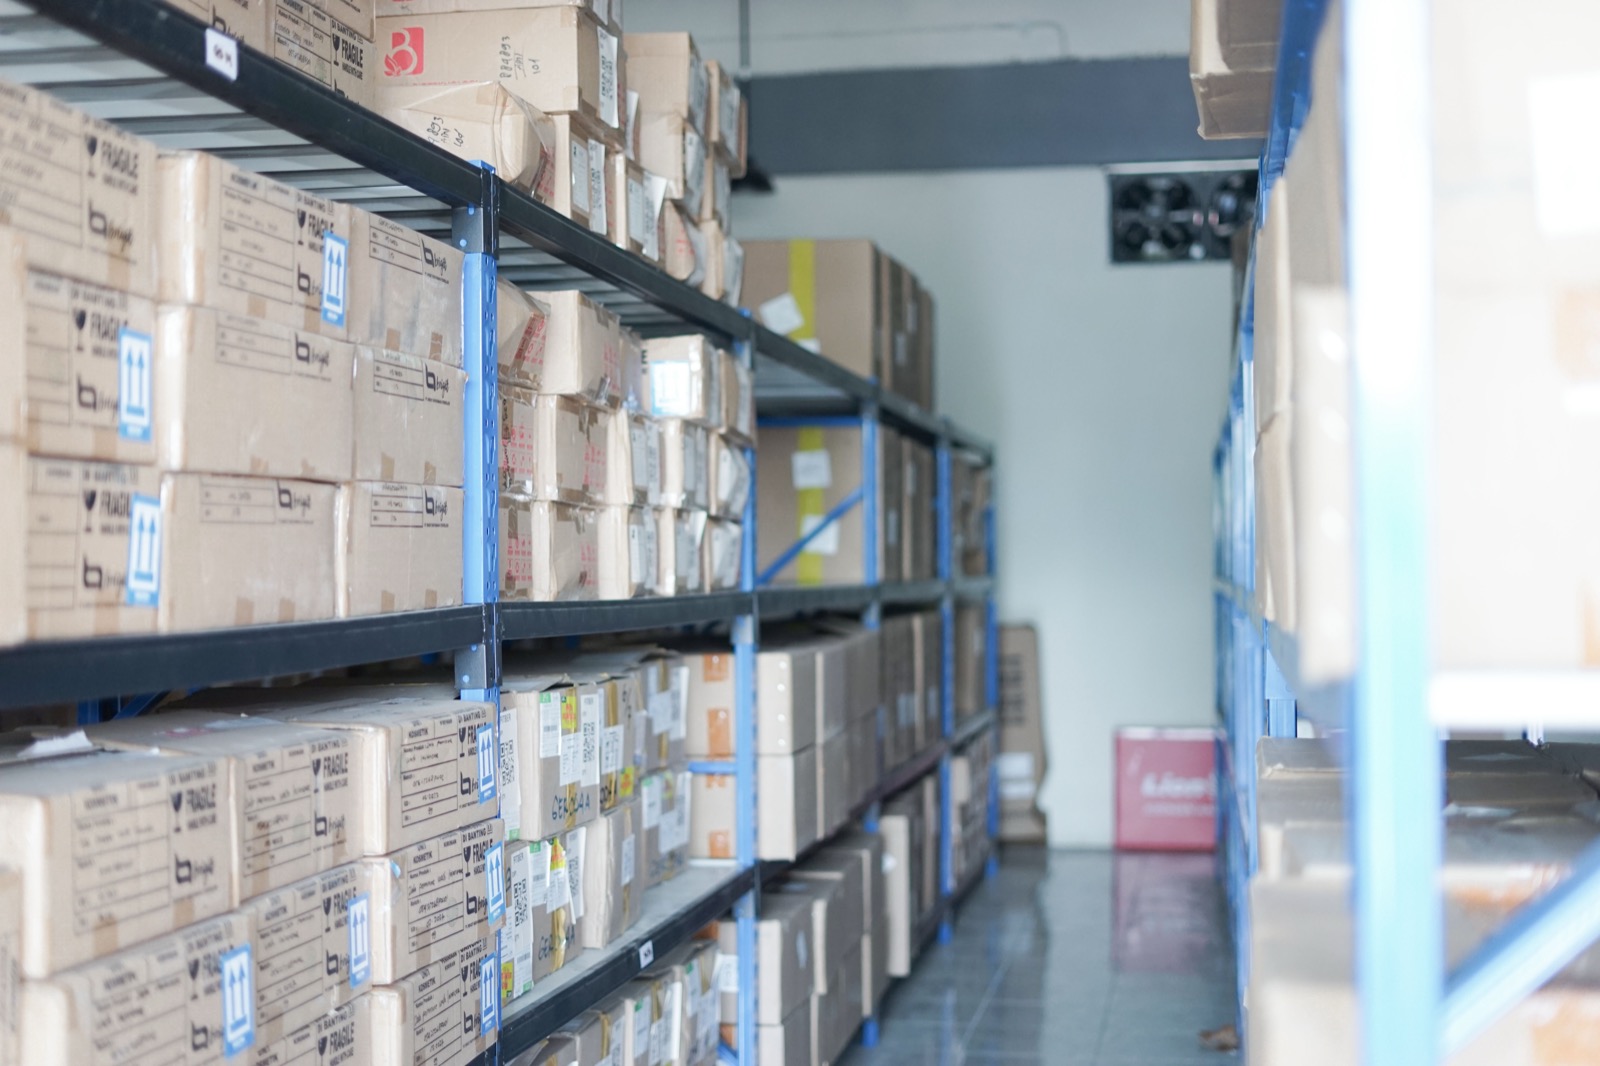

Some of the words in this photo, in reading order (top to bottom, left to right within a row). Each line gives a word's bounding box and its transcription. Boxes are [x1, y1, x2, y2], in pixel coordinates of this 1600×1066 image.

[341, 39, 364, 68] FRAGILE
[323, 752, 348, 780] FRAGILE
[468, 828, 486, 840] BANTING
